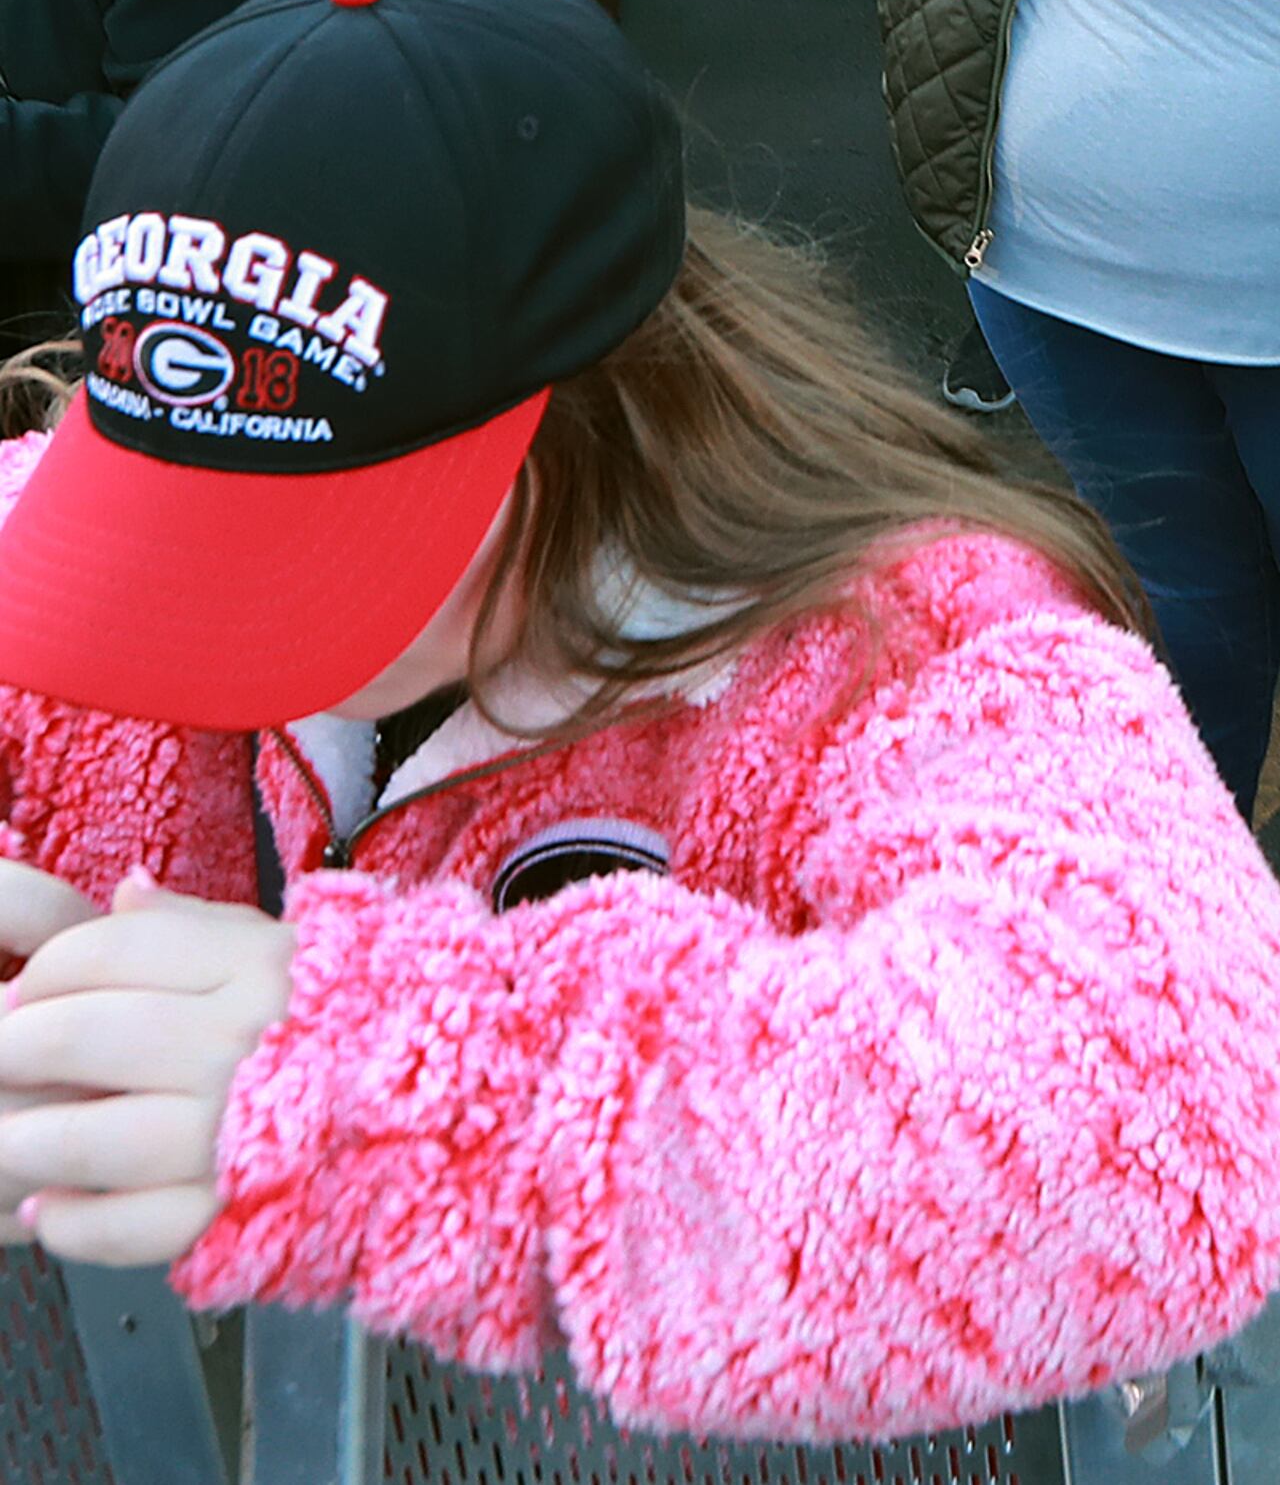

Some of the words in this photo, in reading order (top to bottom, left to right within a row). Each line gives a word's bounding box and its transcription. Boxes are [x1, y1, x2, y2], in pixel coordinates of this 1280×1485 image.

[72, 211, 389, 367] GEORGIA
[136, 288, 236, 331] BOWL
[236, 347, 299, 412] 18
[168, 406, 334, 442] CALIFORNIA
